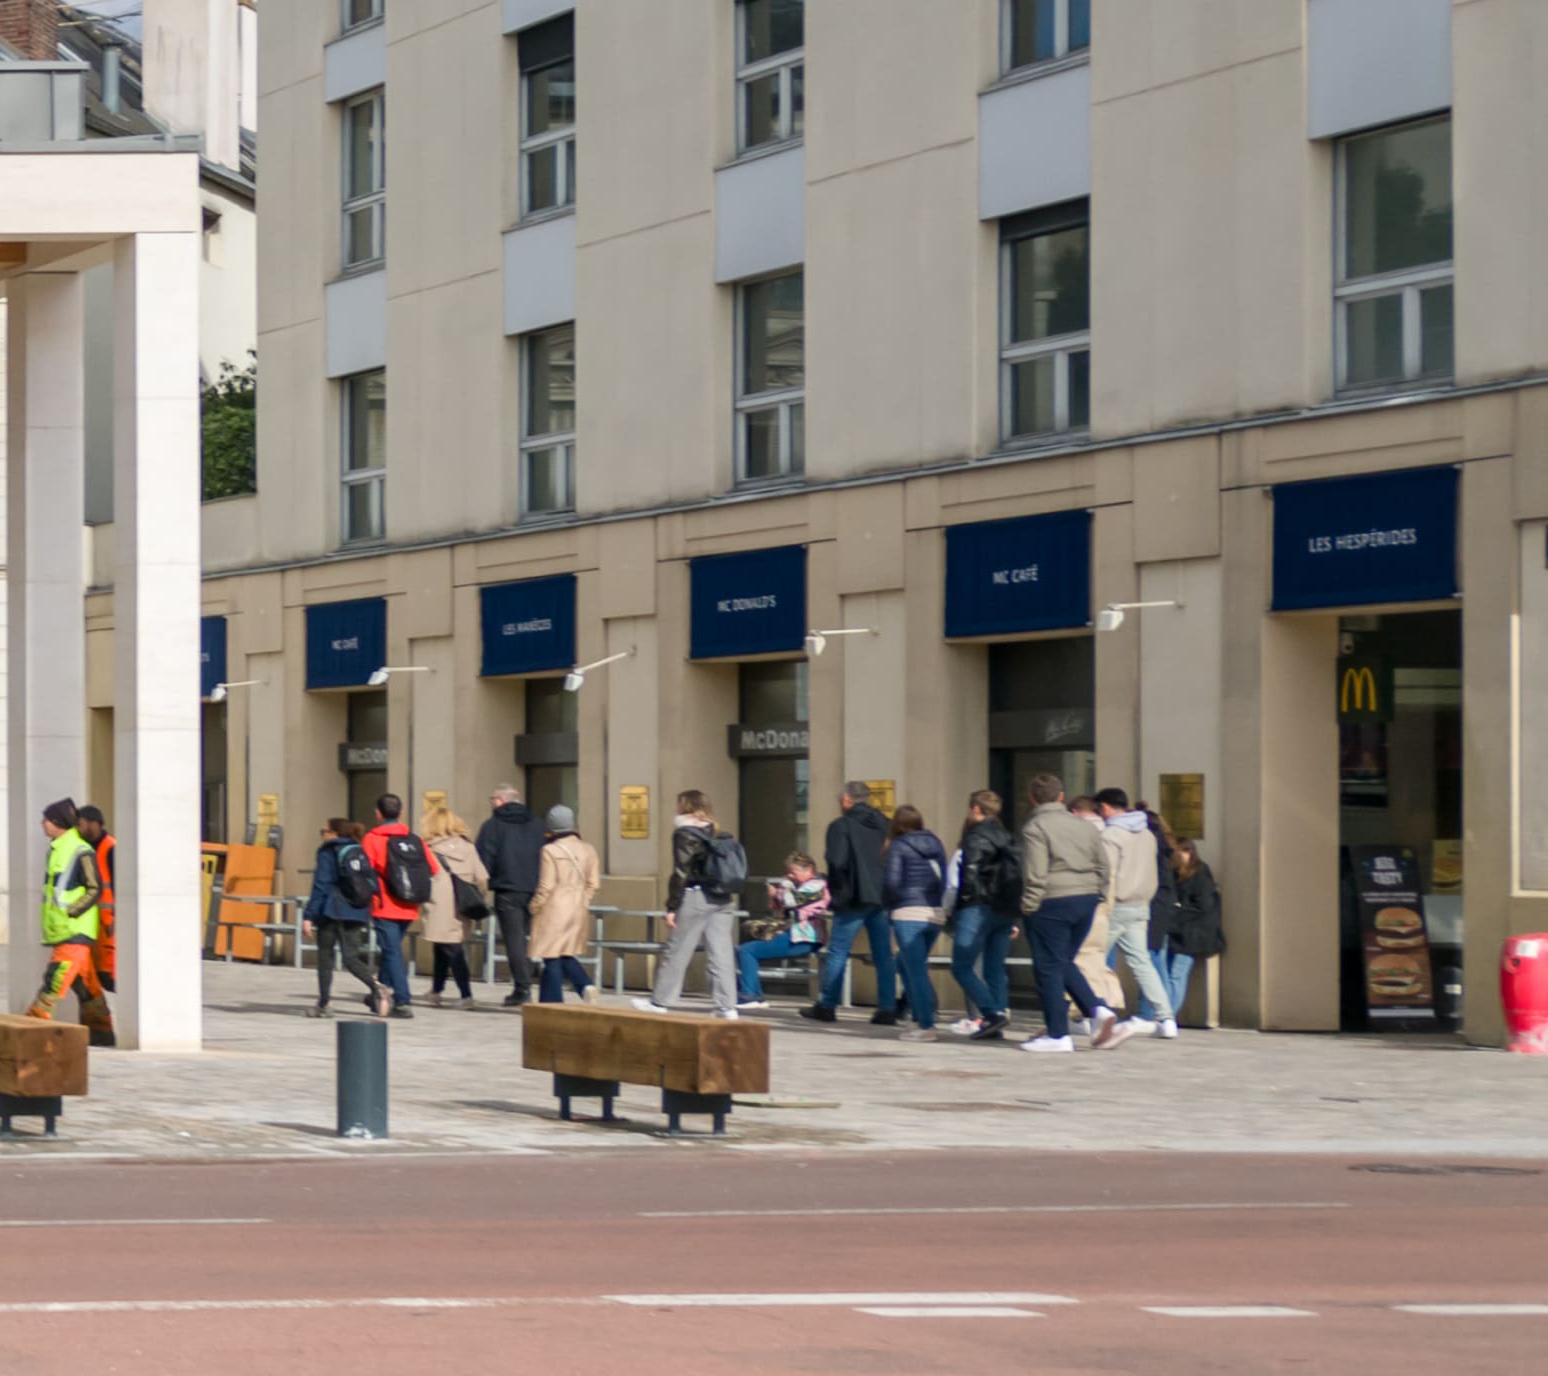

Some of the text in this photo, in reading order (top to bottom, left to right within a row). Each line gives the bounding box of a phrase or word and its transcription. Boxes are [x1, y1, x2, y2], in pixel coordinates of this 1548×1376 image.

[1307, 536, 1333, 554] LES
[992, 563, 1039, 584] MC CAFÉ
